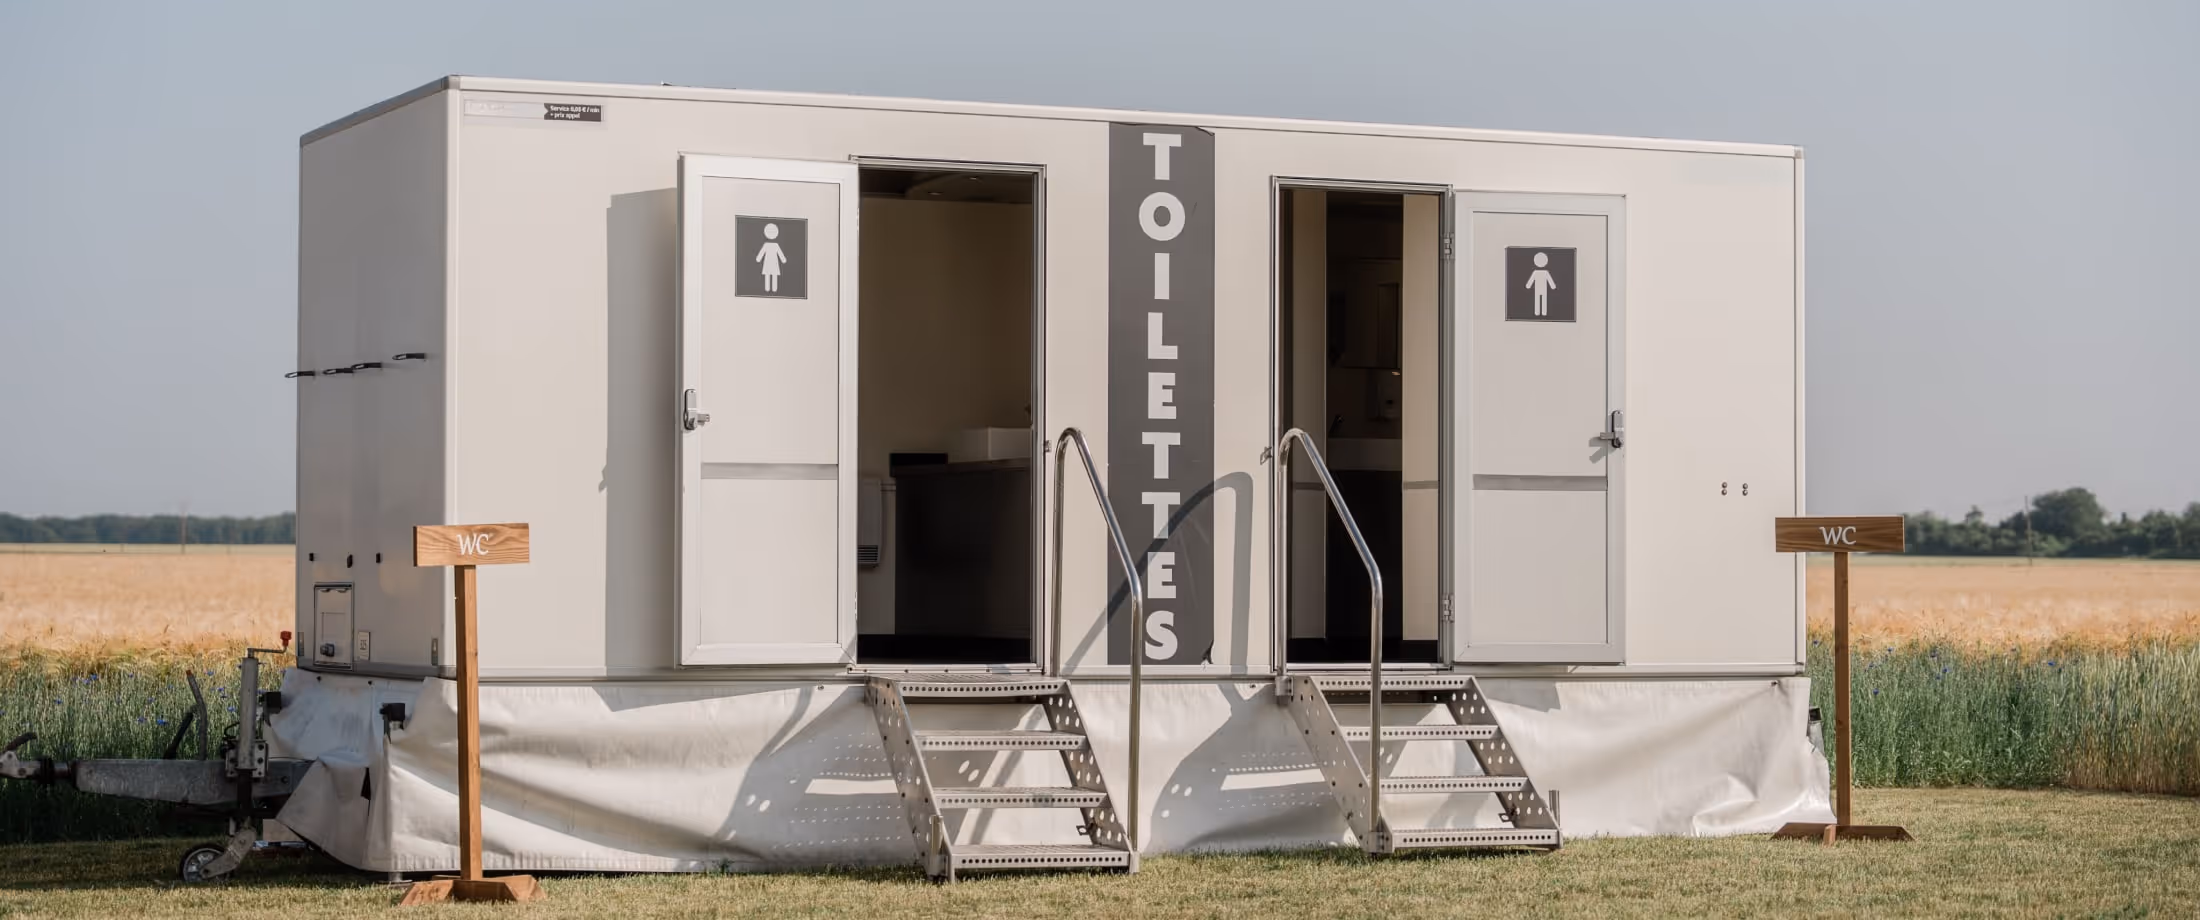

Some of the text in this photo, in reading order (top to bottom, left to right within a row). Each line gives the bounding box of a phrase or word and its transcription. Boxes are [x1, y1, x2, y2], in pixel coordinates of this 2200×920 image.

[1138, 132, 1186, 661] TOILETTES
[456, 532, 489, 556] WC
[1818, 525, 1857, 545] WC
